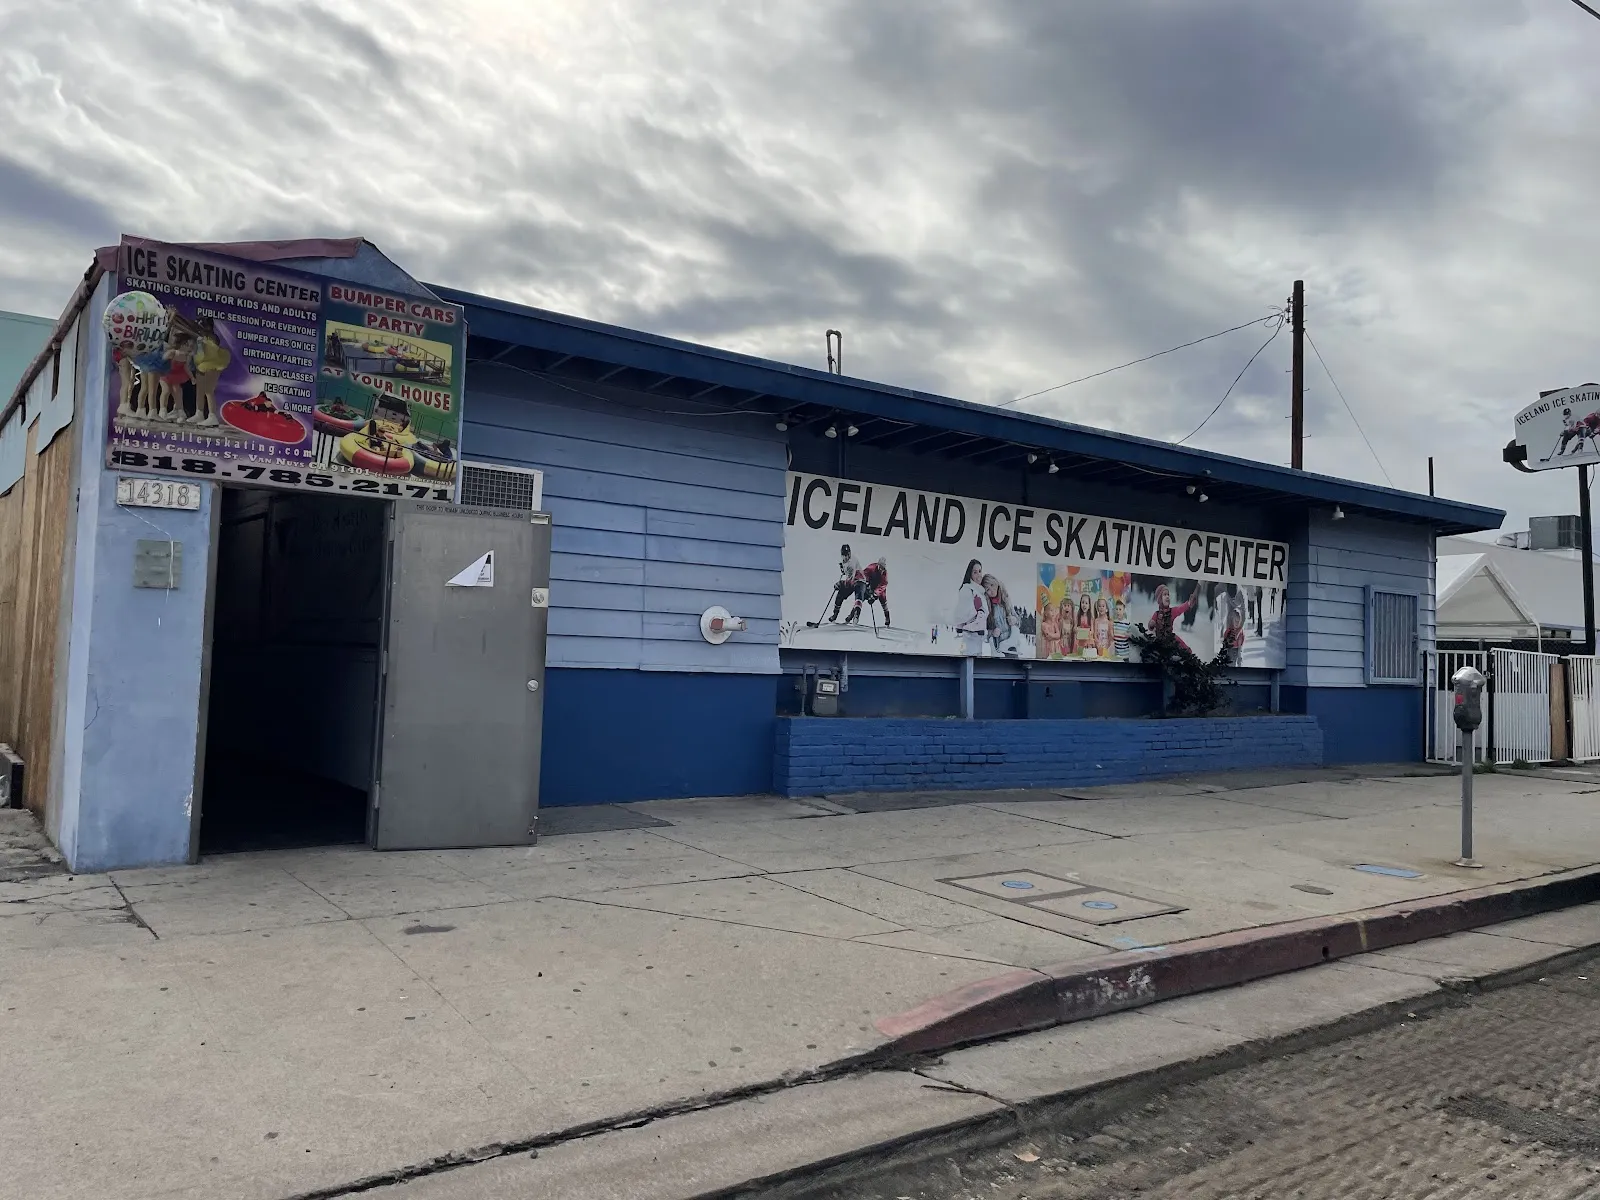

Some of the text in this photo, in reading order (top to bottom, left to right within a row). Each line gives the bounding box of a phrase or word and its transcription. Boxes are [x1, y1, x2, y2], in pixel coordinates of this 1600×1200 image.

[127, 245, 320, 303] ICE SKATING CENTER
[126, 277, 317, 321] SKATING SCHOOL FOR KIDS AND ADULTS
[331, 286, 456, 324] BUMPER CARS
[197, 307, 317, 337] PUBLIC SESSION FOR EVERYONE
[366, 313, 425, 336] PARTY
[237, 330, 316, 352] BUMPER CARS ON ICE
[243, 348, 313, 367] BIRTHDAY PARTIES
[249, 365, 315, 383] HOCKEY CLASSES
[264, 383, 311, 398] ICE SKATING
[322, 367, 451, 412] AT YOUR HOUSE
[283, 402, 313, 414] & MORE
[1516, 403, 1550, 426] ICELAND
[1552, 396, 1567, 408] ICE
[112, 437, 160, 450] 14318
[308, 461, 328, 471] CA
[330, 464, 371, 477] 91401
[114, 425, 313, 459] www.valleyskating.com
[111, 450, 452, 501] 818.785.2171
[125, 479, 190, 506] 14318
[786, 475, 1286, 582] ICELAND ICE SKATING CENTER
